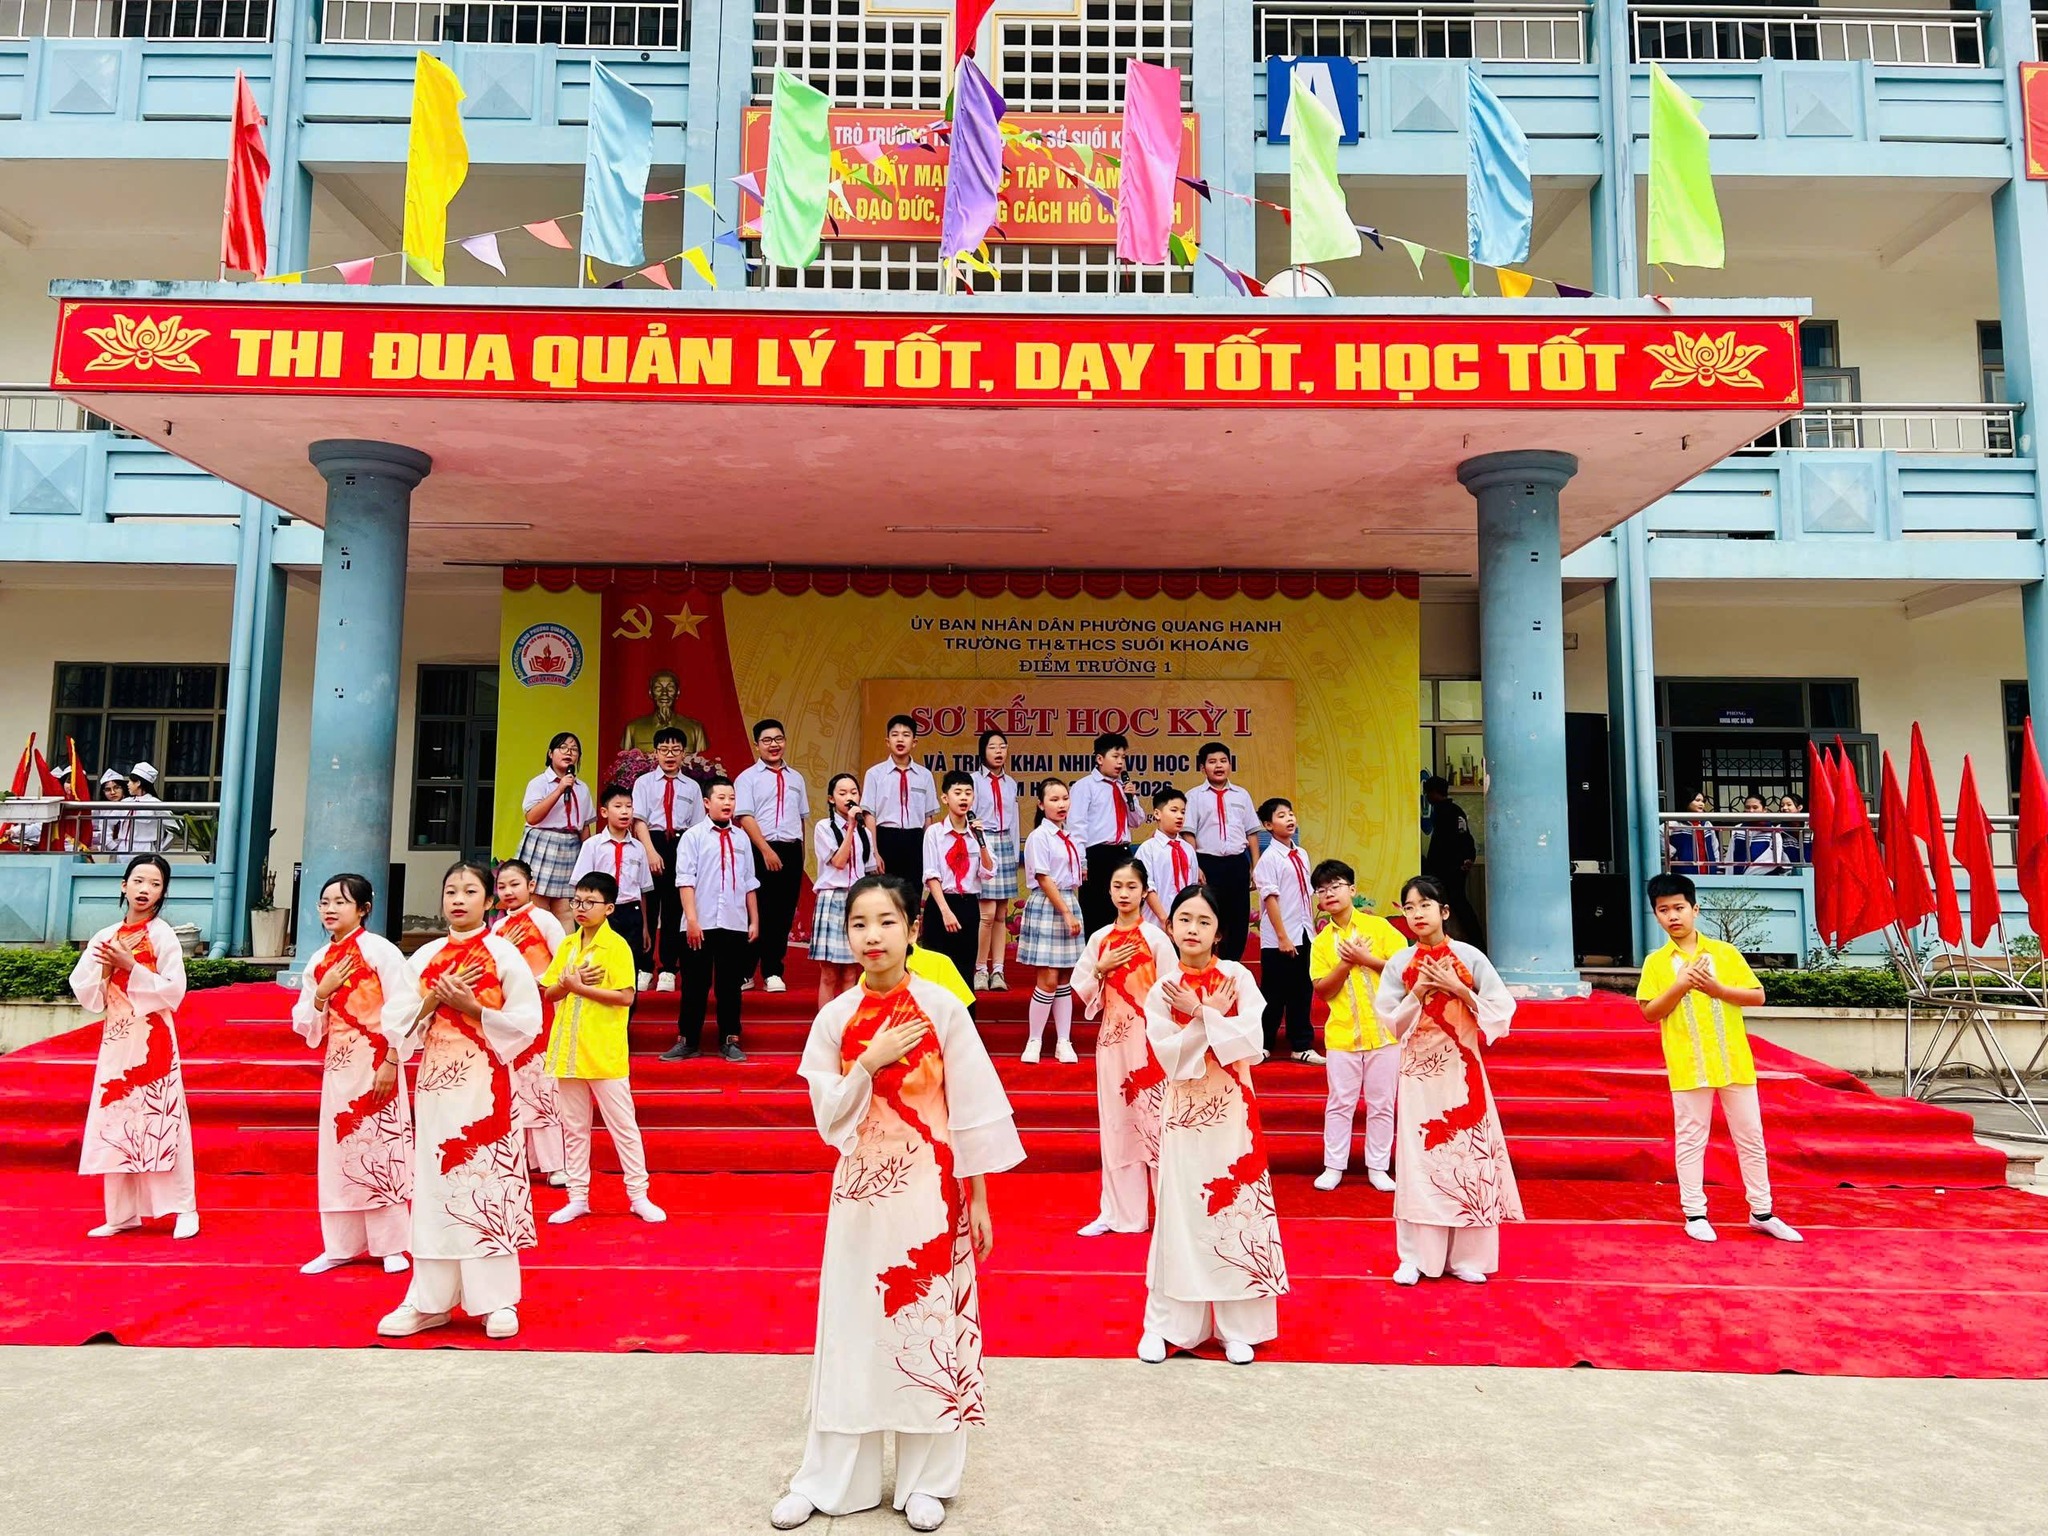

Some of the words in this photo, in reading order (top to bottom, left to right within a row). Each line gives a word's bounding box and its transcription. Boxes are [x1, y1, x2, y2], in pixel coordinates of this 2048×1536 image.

[1280, 62, 1346, 136] A
[834, 122, 863, 145] TRÒ
[1016, 162, 1050, 192] TẬP
[856, 197, 893, 225] ĐẠO
[898, 194, 941, 225] ĐỨC,
[1013, 196, 1062, 224] CÁCH
[1067, 194, 1092, 224] HỒ
[230, 328, 344, 378] THI
[369, 332, 515, 382] ĐUA
[532, 322, 733, 388] QUẢN
[757, 328, 836, 387] LÝ
[854, 324, 995, 393] TỐT,
[1015, 341, 1155, 399] DẠY
[1174, 327, 1315, 394] TỐT,
[1335, 342, 1481, 400] HỌC
[1498, 327, 1626, 392] TỐT
[911, 615, 934, 630] ỦY
[939, 618, 976, 631] BAN
[981, 616, 1033, 631] NHÂN
[1037, 617, 1075, 632] DÂN
[1080, 617, 1156, 632] PHƯỜNG
[1161, 620, 1225, 634] QUANG
[1229, 620, 1282, 632] HANH
[943, 636, 1022, 650] TRƯỜNG
[1026, 638, 1116, 651] TH&THCS
[1121, 636, 1164, 651] SUỐI
[1170, 637, 1249, 652] KHOÁNG
[1019, 652, 1070, 673] ĐIỂM
[1075, 657, 1156, 673] TRƯỜNG
[1164, 661, 1172, 673] 1
[911, 706, 966, 736] SƠ
[974, 694, 1058, 736] KẾT
[1168, 700, 1227, 737] KỲ
[1234, 708, 1252, 737] I
[923, 751, 947, 772] VÀ
[1011, 754, 1053, 772] KHAI
[1125, 754, 1147, 776] VỤ
[1153, 754, 1190, 776] HỌC
